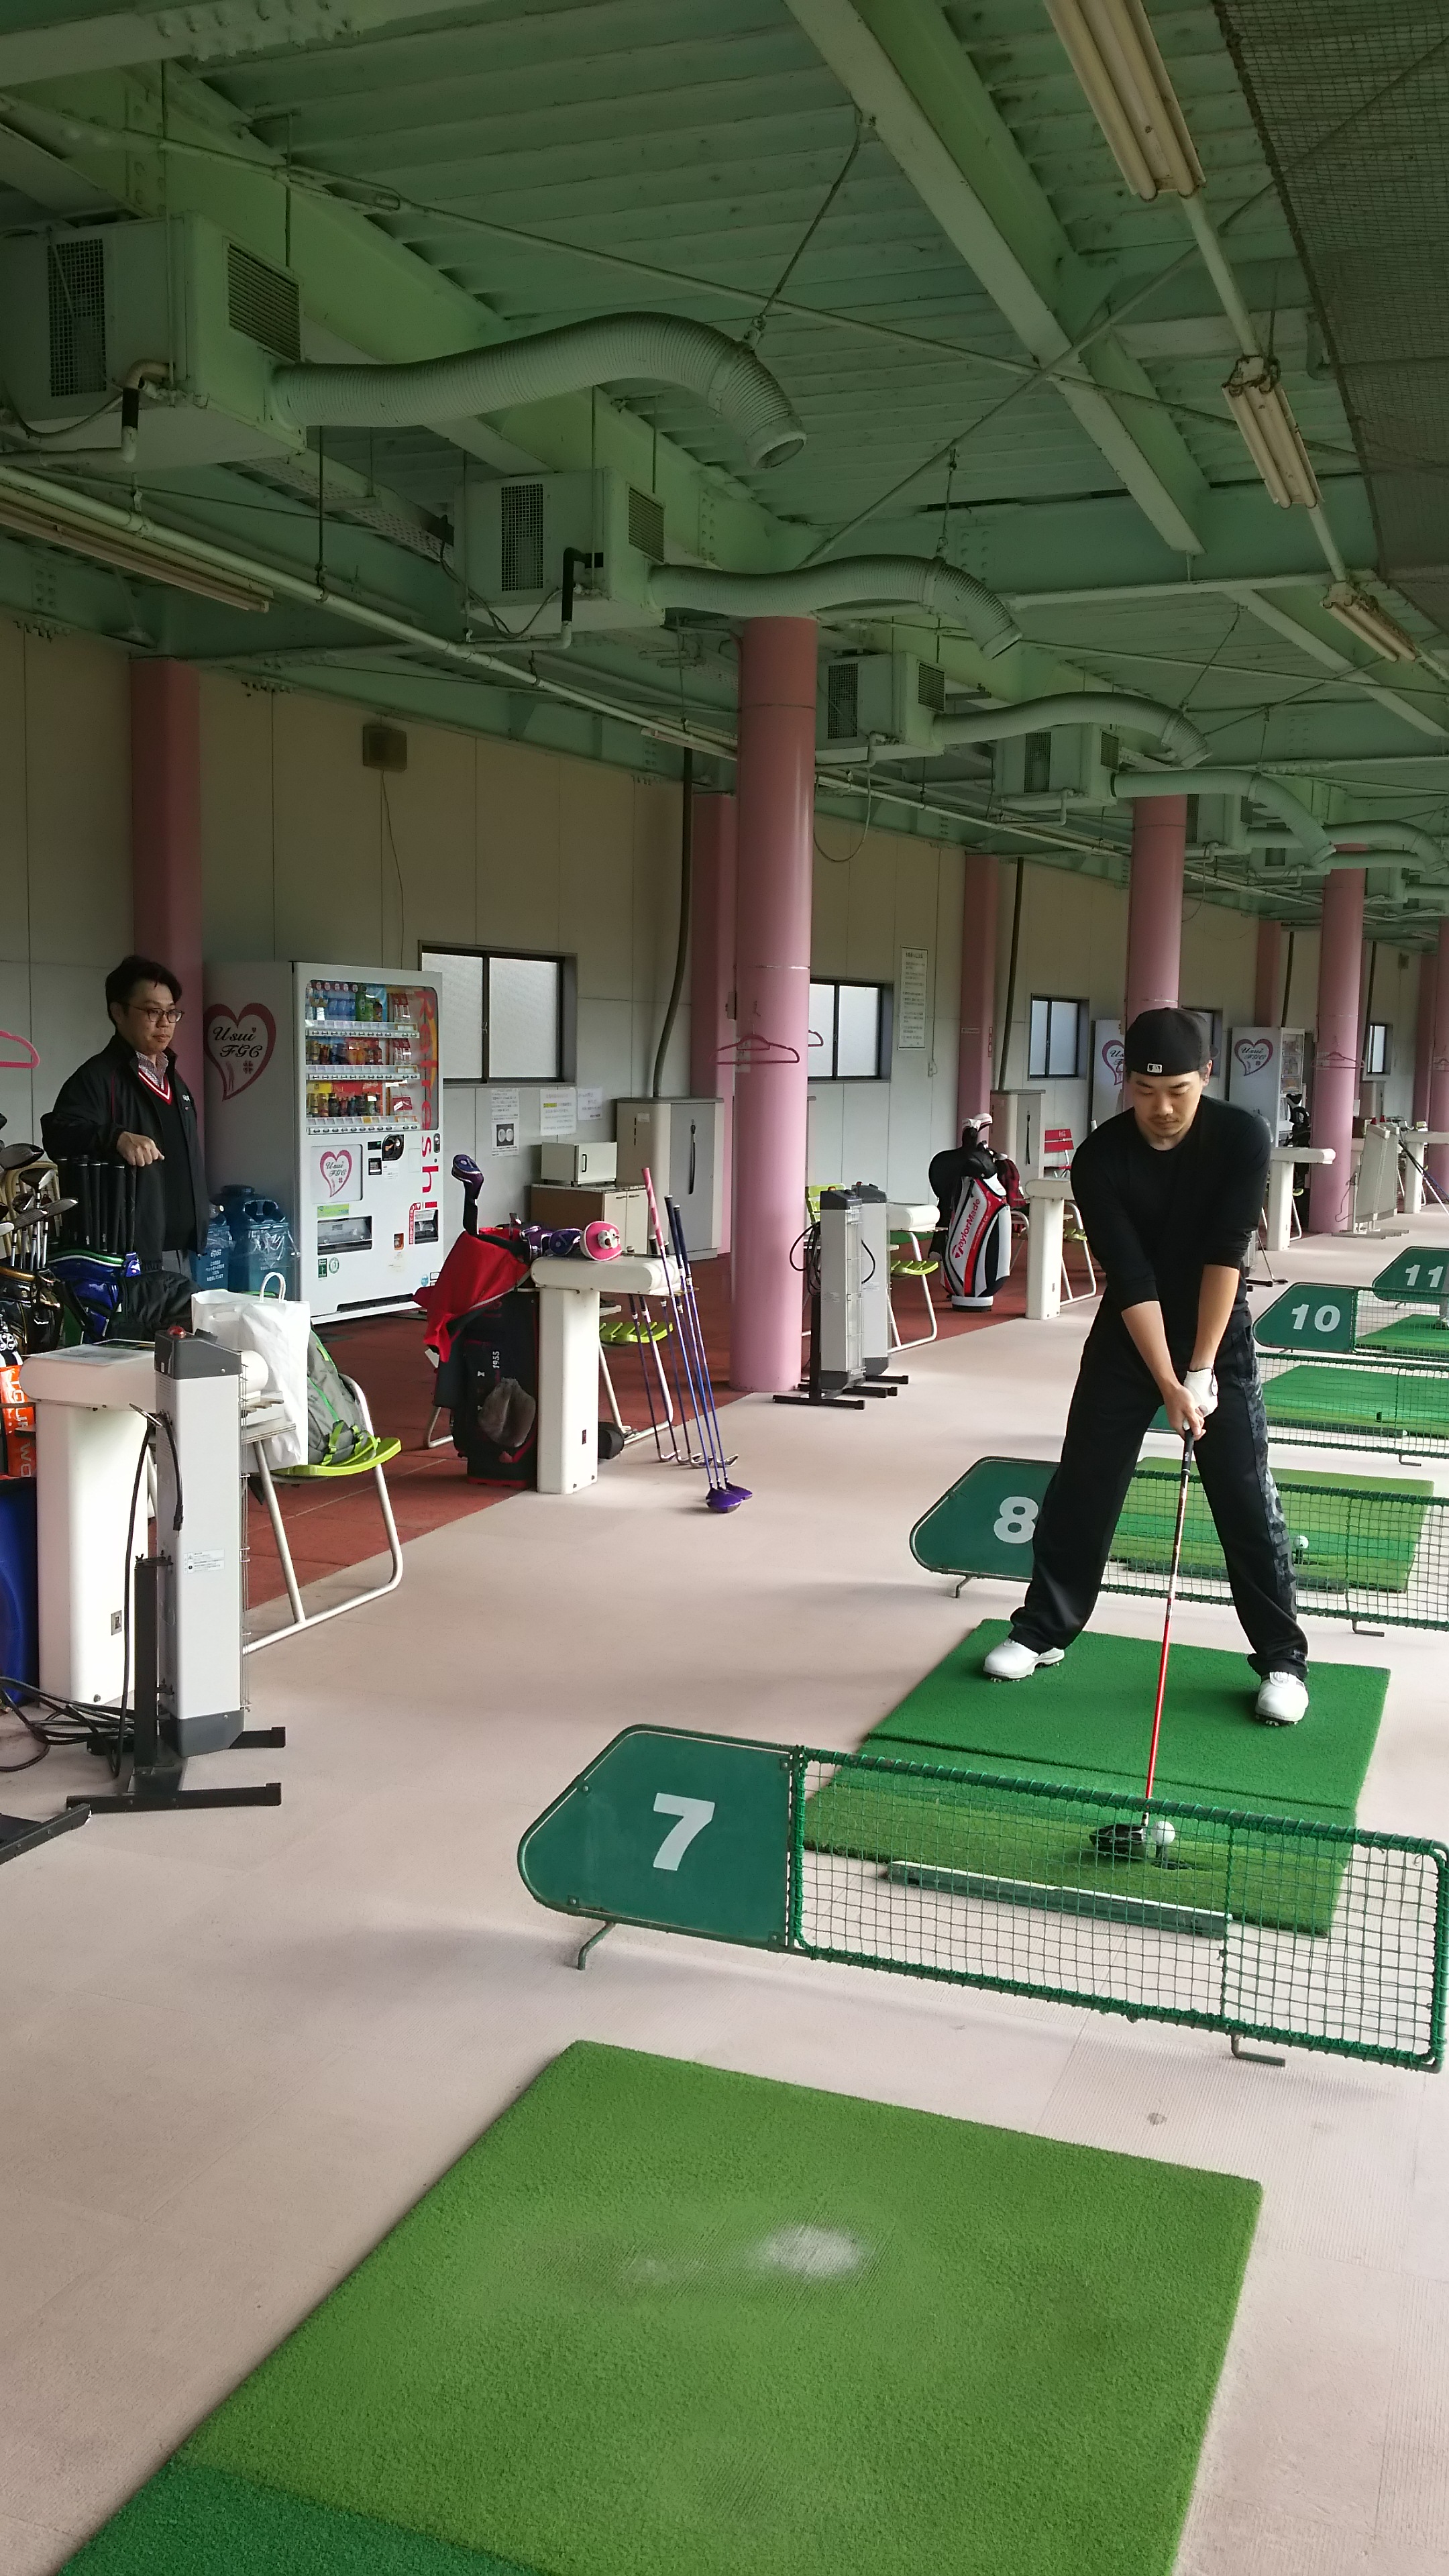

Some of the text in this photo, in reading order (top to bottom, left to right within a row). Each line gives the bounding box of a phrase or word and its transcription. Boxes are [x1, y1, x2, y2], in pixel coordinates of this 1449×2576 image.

[213, 1026, 256, 1041] Usui
[219, 1044, 263, 1058] FGC
[1110, 1050, 1124, 1058] Us
[952, 1199, 981, 1258] TaylorMade
[1405, 1265, 1444, 1288] 11
[1291, 1303, 1341, 1332] 10
[492, 1351, 500, 1368] 1955
[994, 1496, 1039, 1544] 8
[653, 1792, 716, 1871] 7
